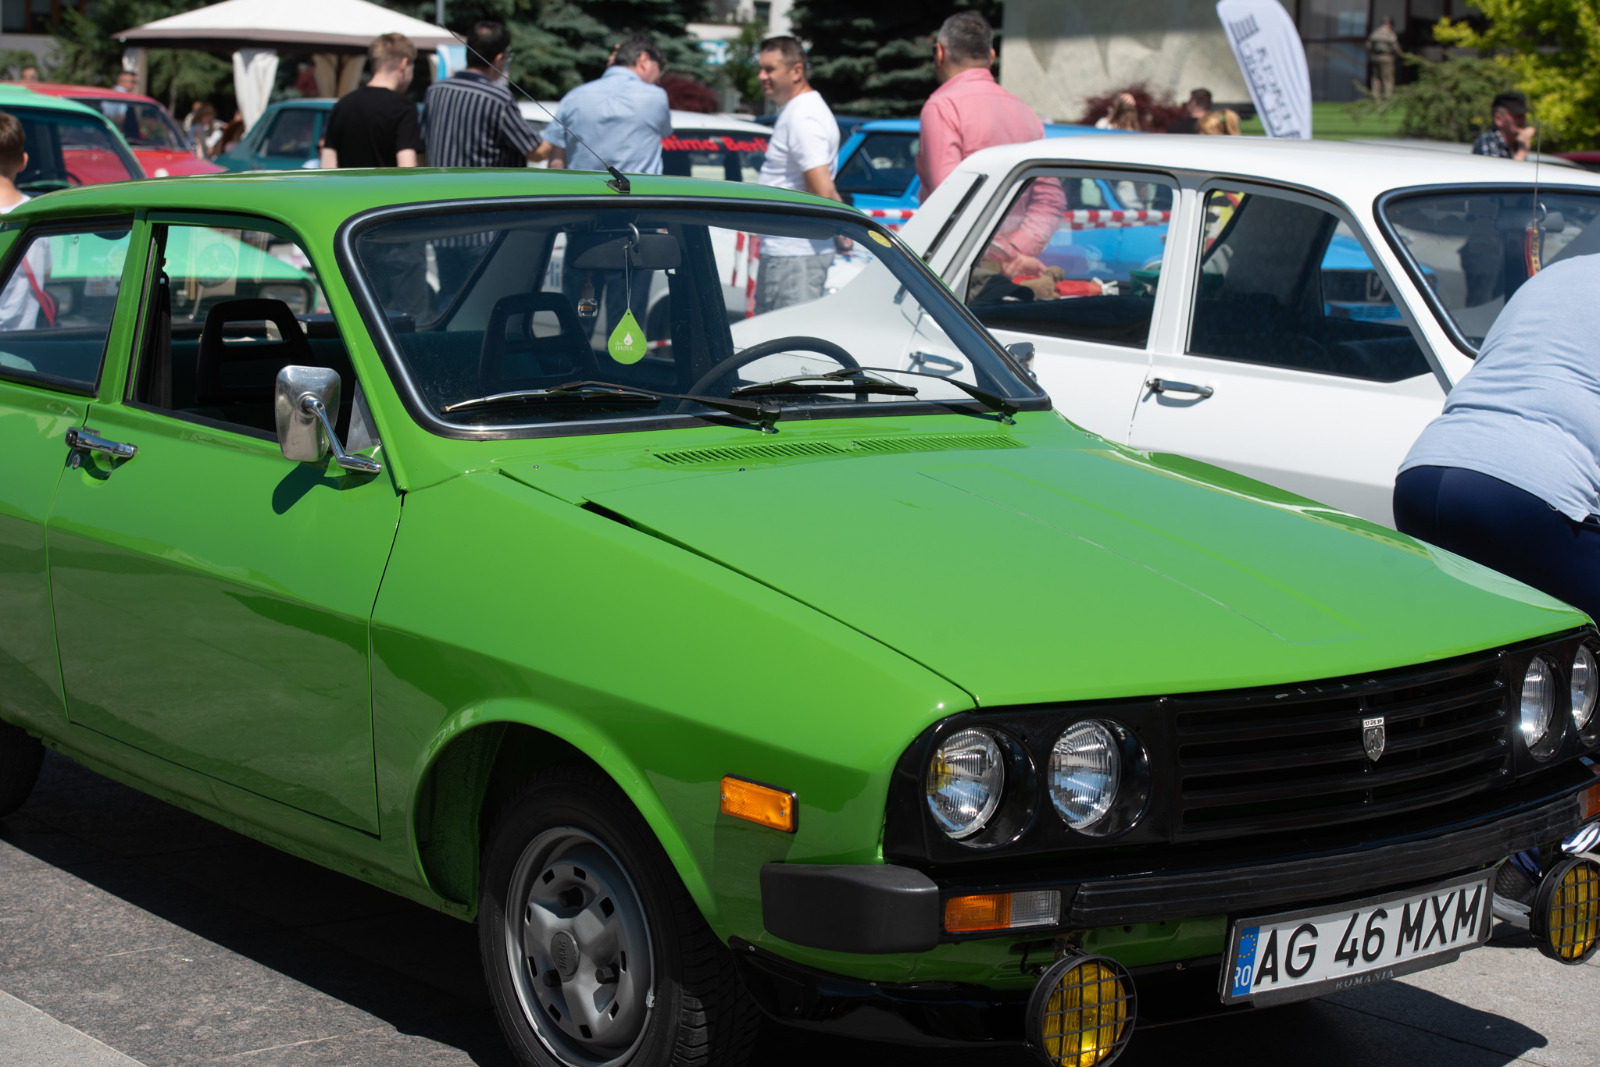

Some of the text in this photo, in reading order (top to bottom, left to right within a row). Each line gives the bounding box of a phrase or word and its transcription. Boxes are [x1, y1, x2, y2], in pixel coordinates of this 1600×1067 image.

[660, 134, 719, 151] ltima
[1253, 884, 1483, 986] AG 46 MXM
[1234, 965, 1252, 988] RO
[1335, 969, 1395, 990] ROMANIA
